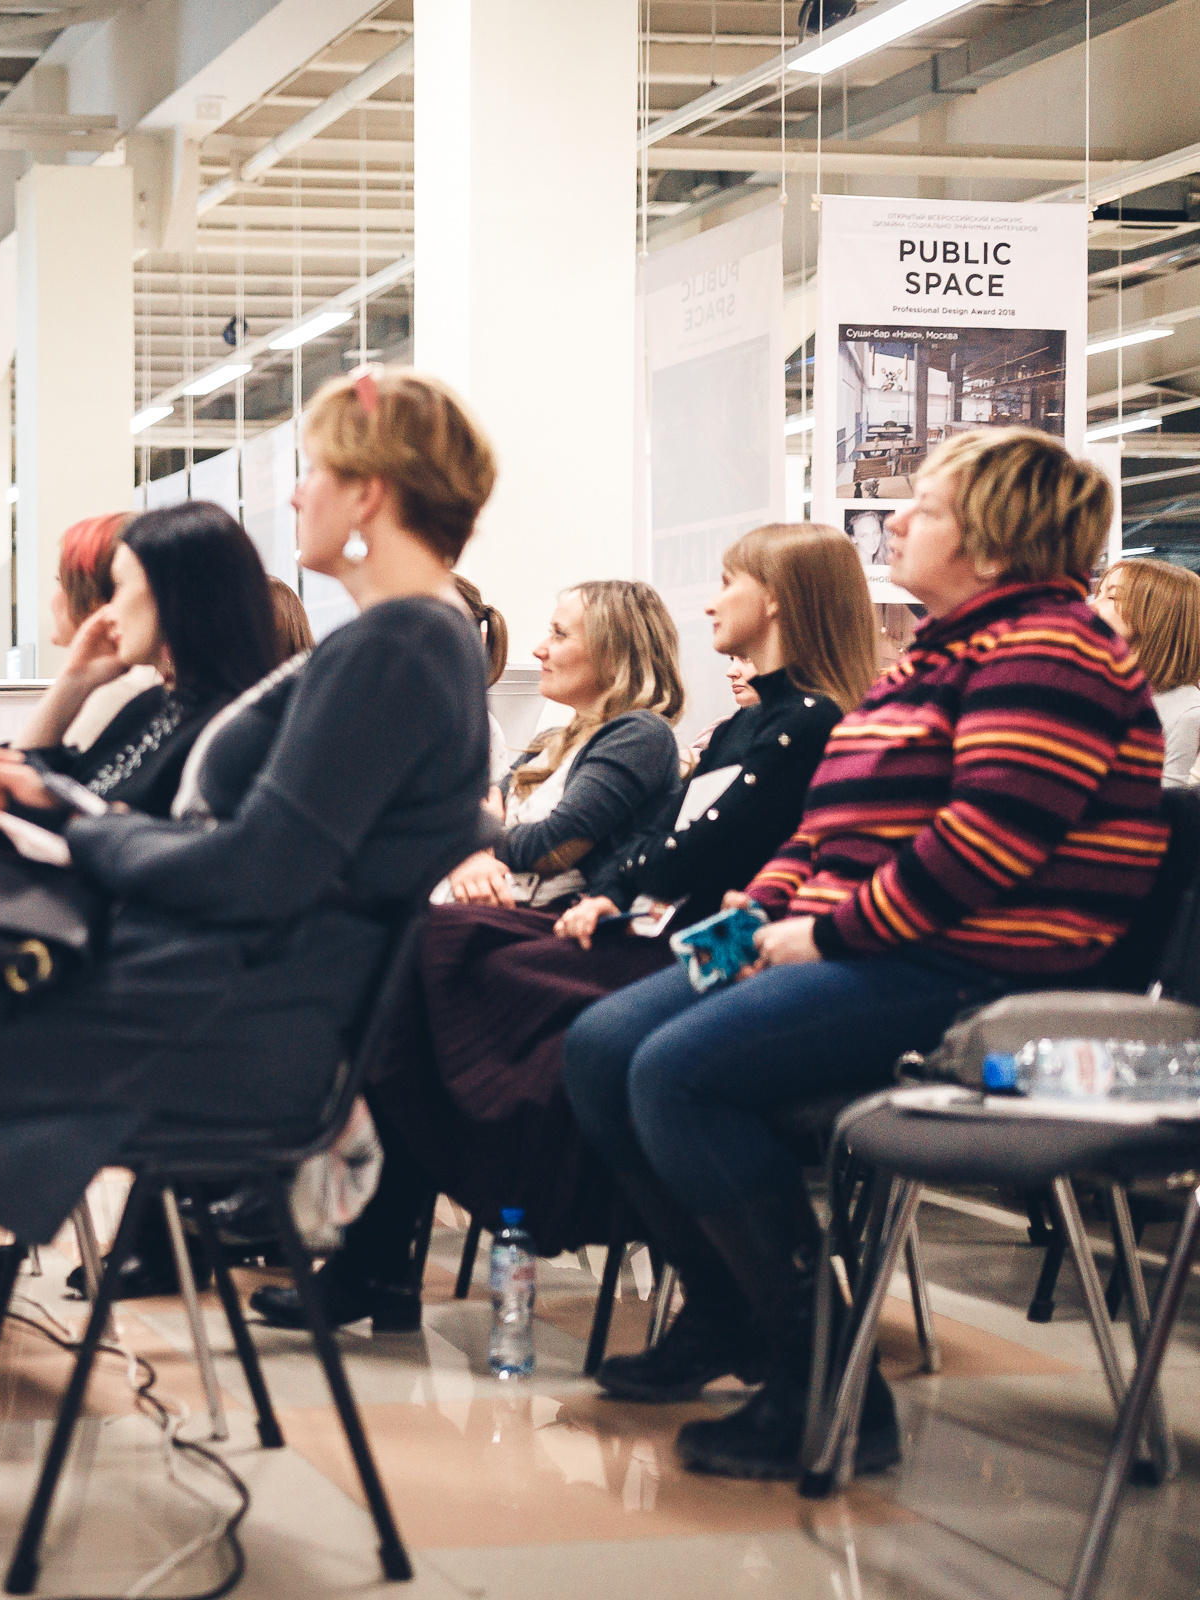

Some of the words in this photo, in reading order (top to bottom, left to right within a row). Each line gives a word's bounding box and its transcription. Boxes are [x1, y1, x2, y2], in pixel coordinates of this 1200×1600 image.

[990, 216, 1024, 224] КОНКУРС
[899, 239, 1012, 265] PUBLIC
[905, 271, 1005, 297] SPACE
[892, 305, 939, 314] Professional
[942, 307, 968, 316] Design
[971, 308, 996, 316] Award
[846, 328, 890, 339] Суши-бар
[926, 331, 958, 340] Москва
